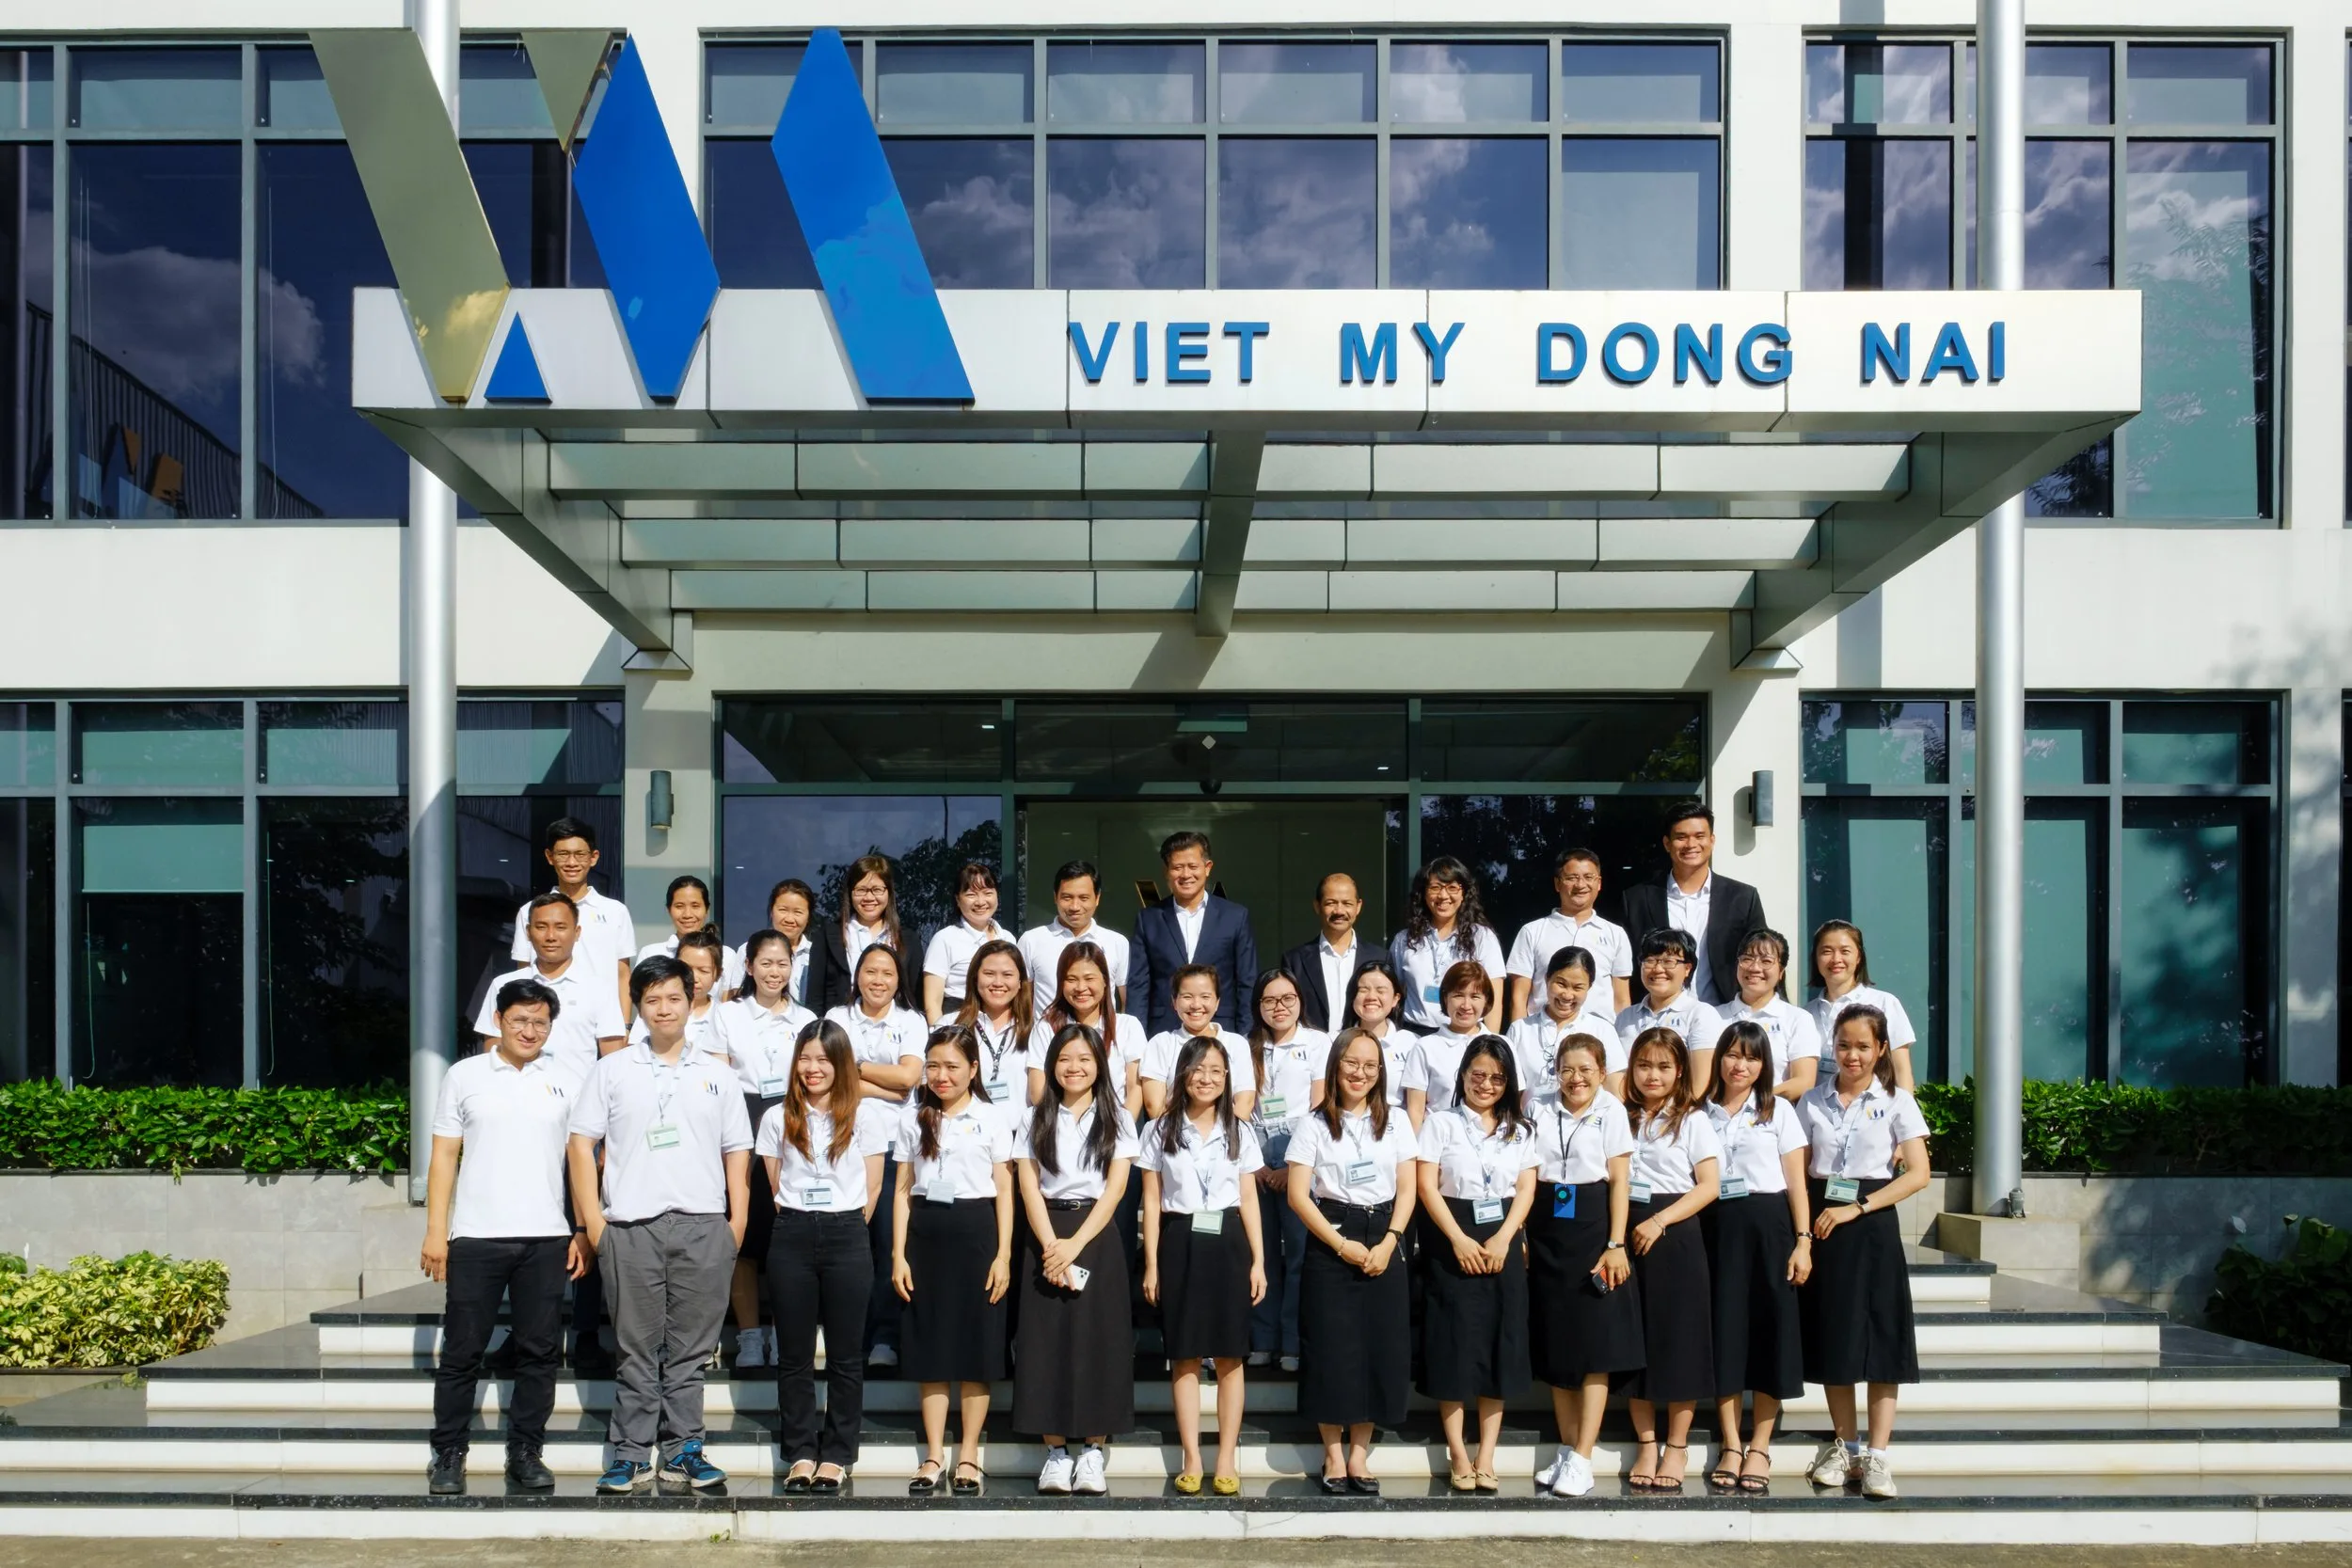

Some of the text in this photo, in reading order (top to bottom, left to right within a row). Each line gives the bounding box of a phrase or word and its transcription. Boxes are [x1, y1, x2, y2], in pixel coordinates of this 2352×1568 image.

[1067, 321, 2005, 383] VIET MY DONG NAI
